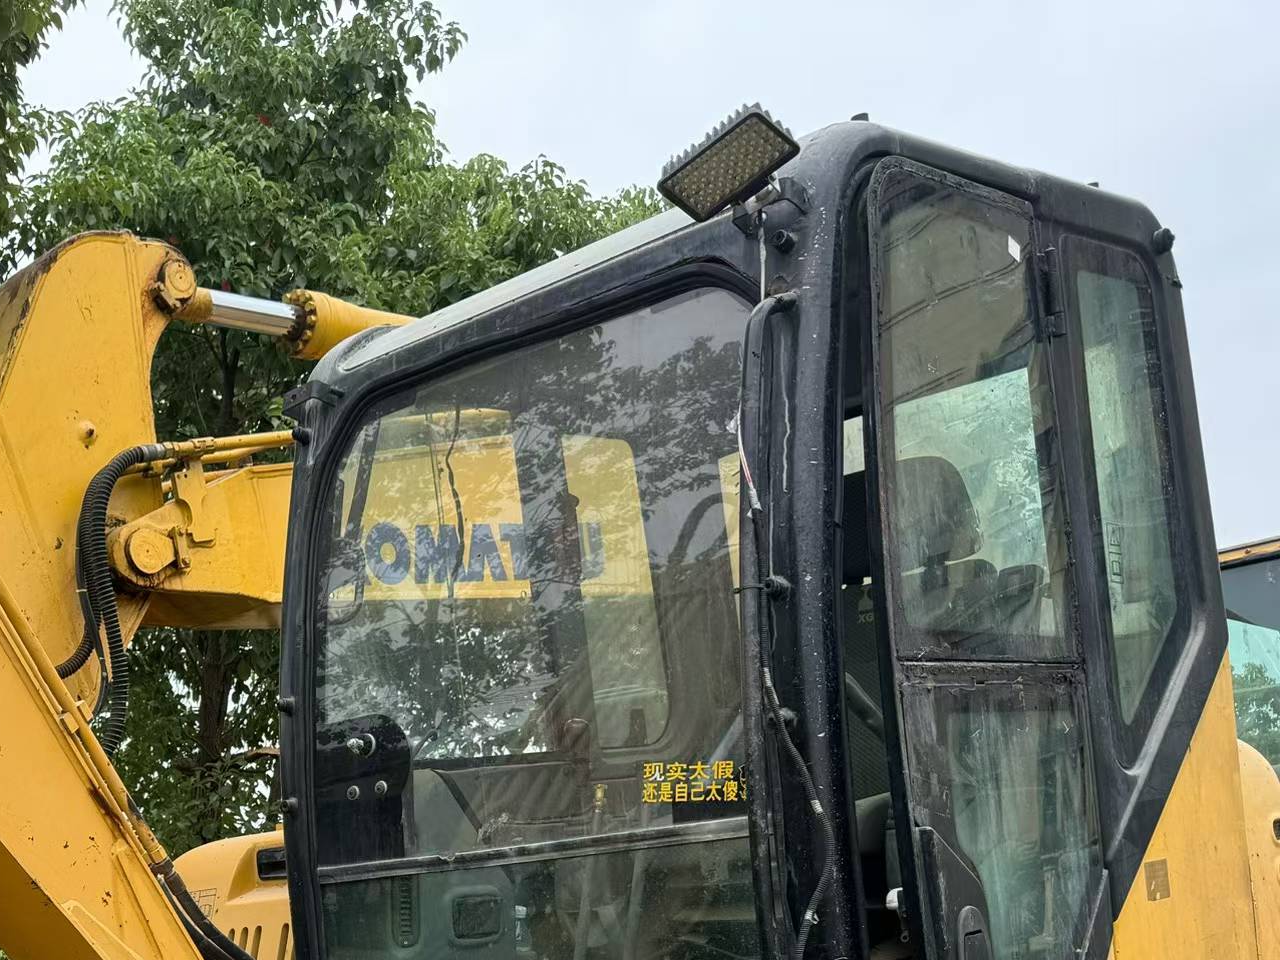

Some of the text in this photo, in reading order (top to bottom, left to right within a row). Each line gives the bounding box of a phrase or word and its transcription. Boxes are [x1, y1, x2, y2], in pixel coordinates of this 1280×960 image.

[643, 761, 734, 781] 现实太假
[642, 781, 738, 802] 还是自己太傻
